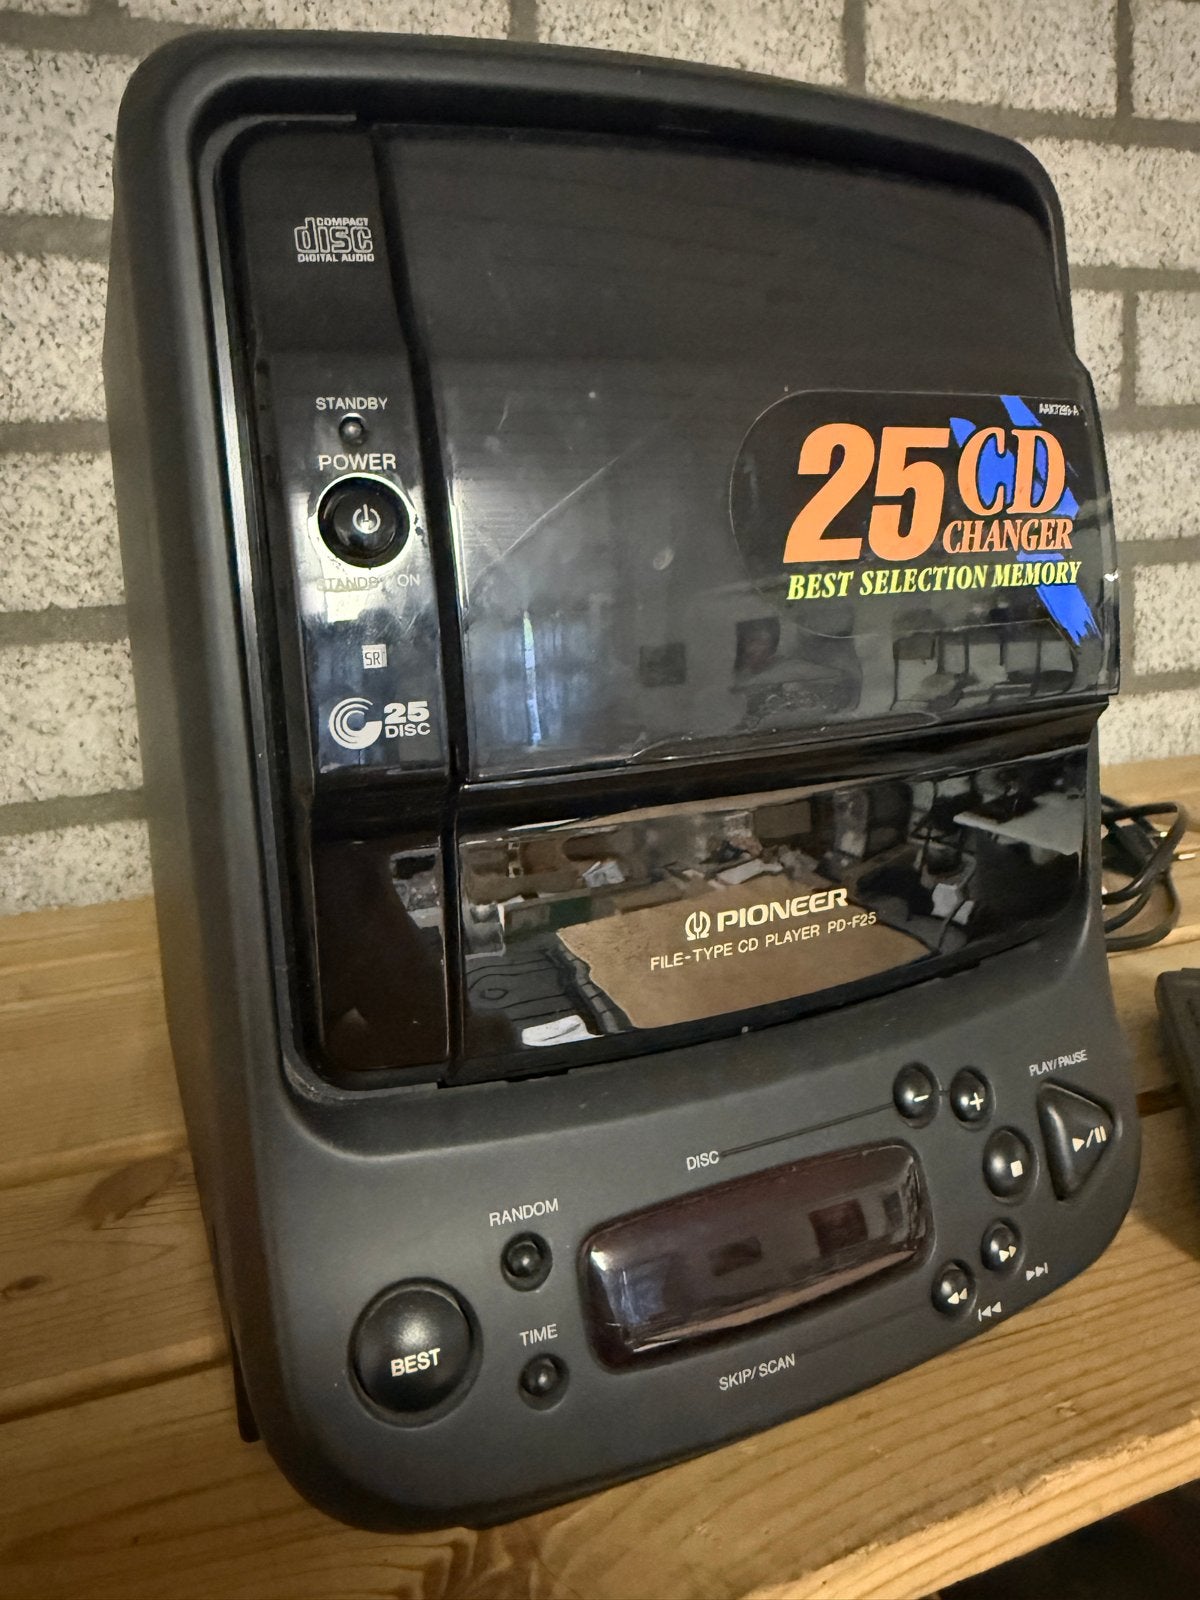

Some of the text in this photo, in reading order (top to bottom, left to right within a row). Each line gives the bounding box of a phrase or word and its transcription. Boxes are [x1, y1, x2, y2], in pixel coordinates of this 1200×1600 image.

[316, 217, 369, 226] COMPACT
[298, 253, 375, 262] DIGITAL AUDIO
[315, 396, 388, 411] STANDBY
[318, 453, 397, 471] POWER
[782, 422, 1066, 564] 25 CD
[942, 518, 1074, 554] CHANGER
[786, 561, 1082, 600] BEST SELECTION MEMORY
[383, 700, 430, 725] 25
[384, 723, 431, 739] DISC
[717, 887, 849, 933] PIONEER
[650, 911, 877, 971] FILE-TYPE CD PLAYER PD-F25
[686, 1150, 720, 1172] DISC
[488, 1198, 560, 1227] RANDOM
[519, 1323, 559, 1347] TIME
[390, 1347, 442, 1378] BEST
